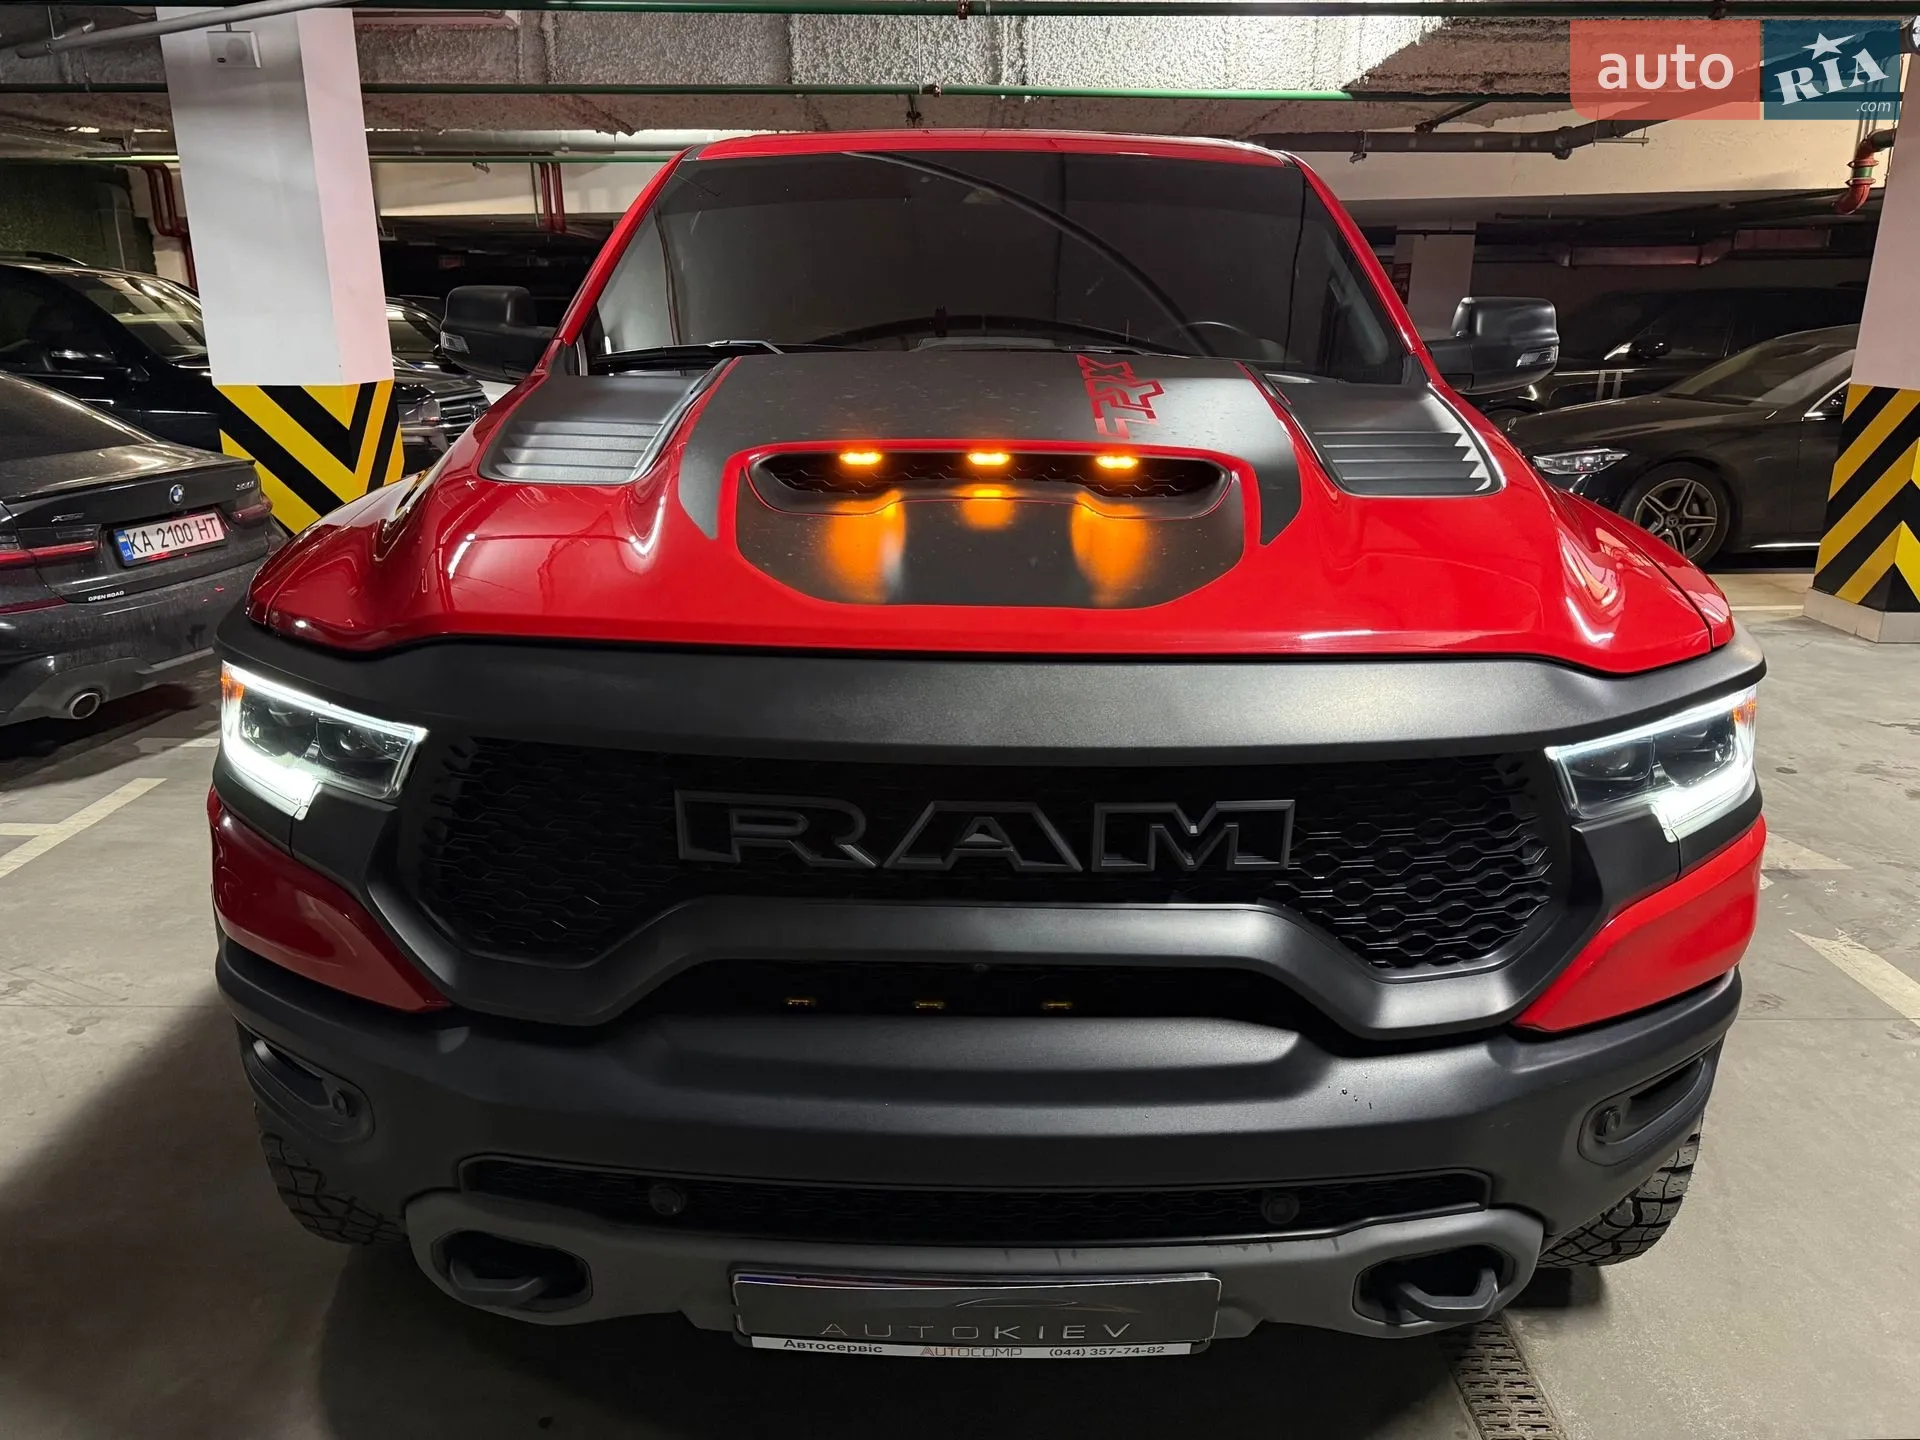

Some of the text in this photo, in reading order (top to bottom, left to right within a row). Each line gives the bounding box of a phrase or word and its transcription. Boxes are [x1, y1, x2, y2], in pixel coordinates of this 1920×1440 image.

[126, 517, 218, 555] KA 2100 HT
[106, 590, 125, 598] ROAD
[674, 789, 1296, 872] RAM
[819, 1323, 1131, 1340] AUTOKIEV
[783, 1339, 1166, 1358] Автосервіс AUTOCOMP (044) 357-74-82
